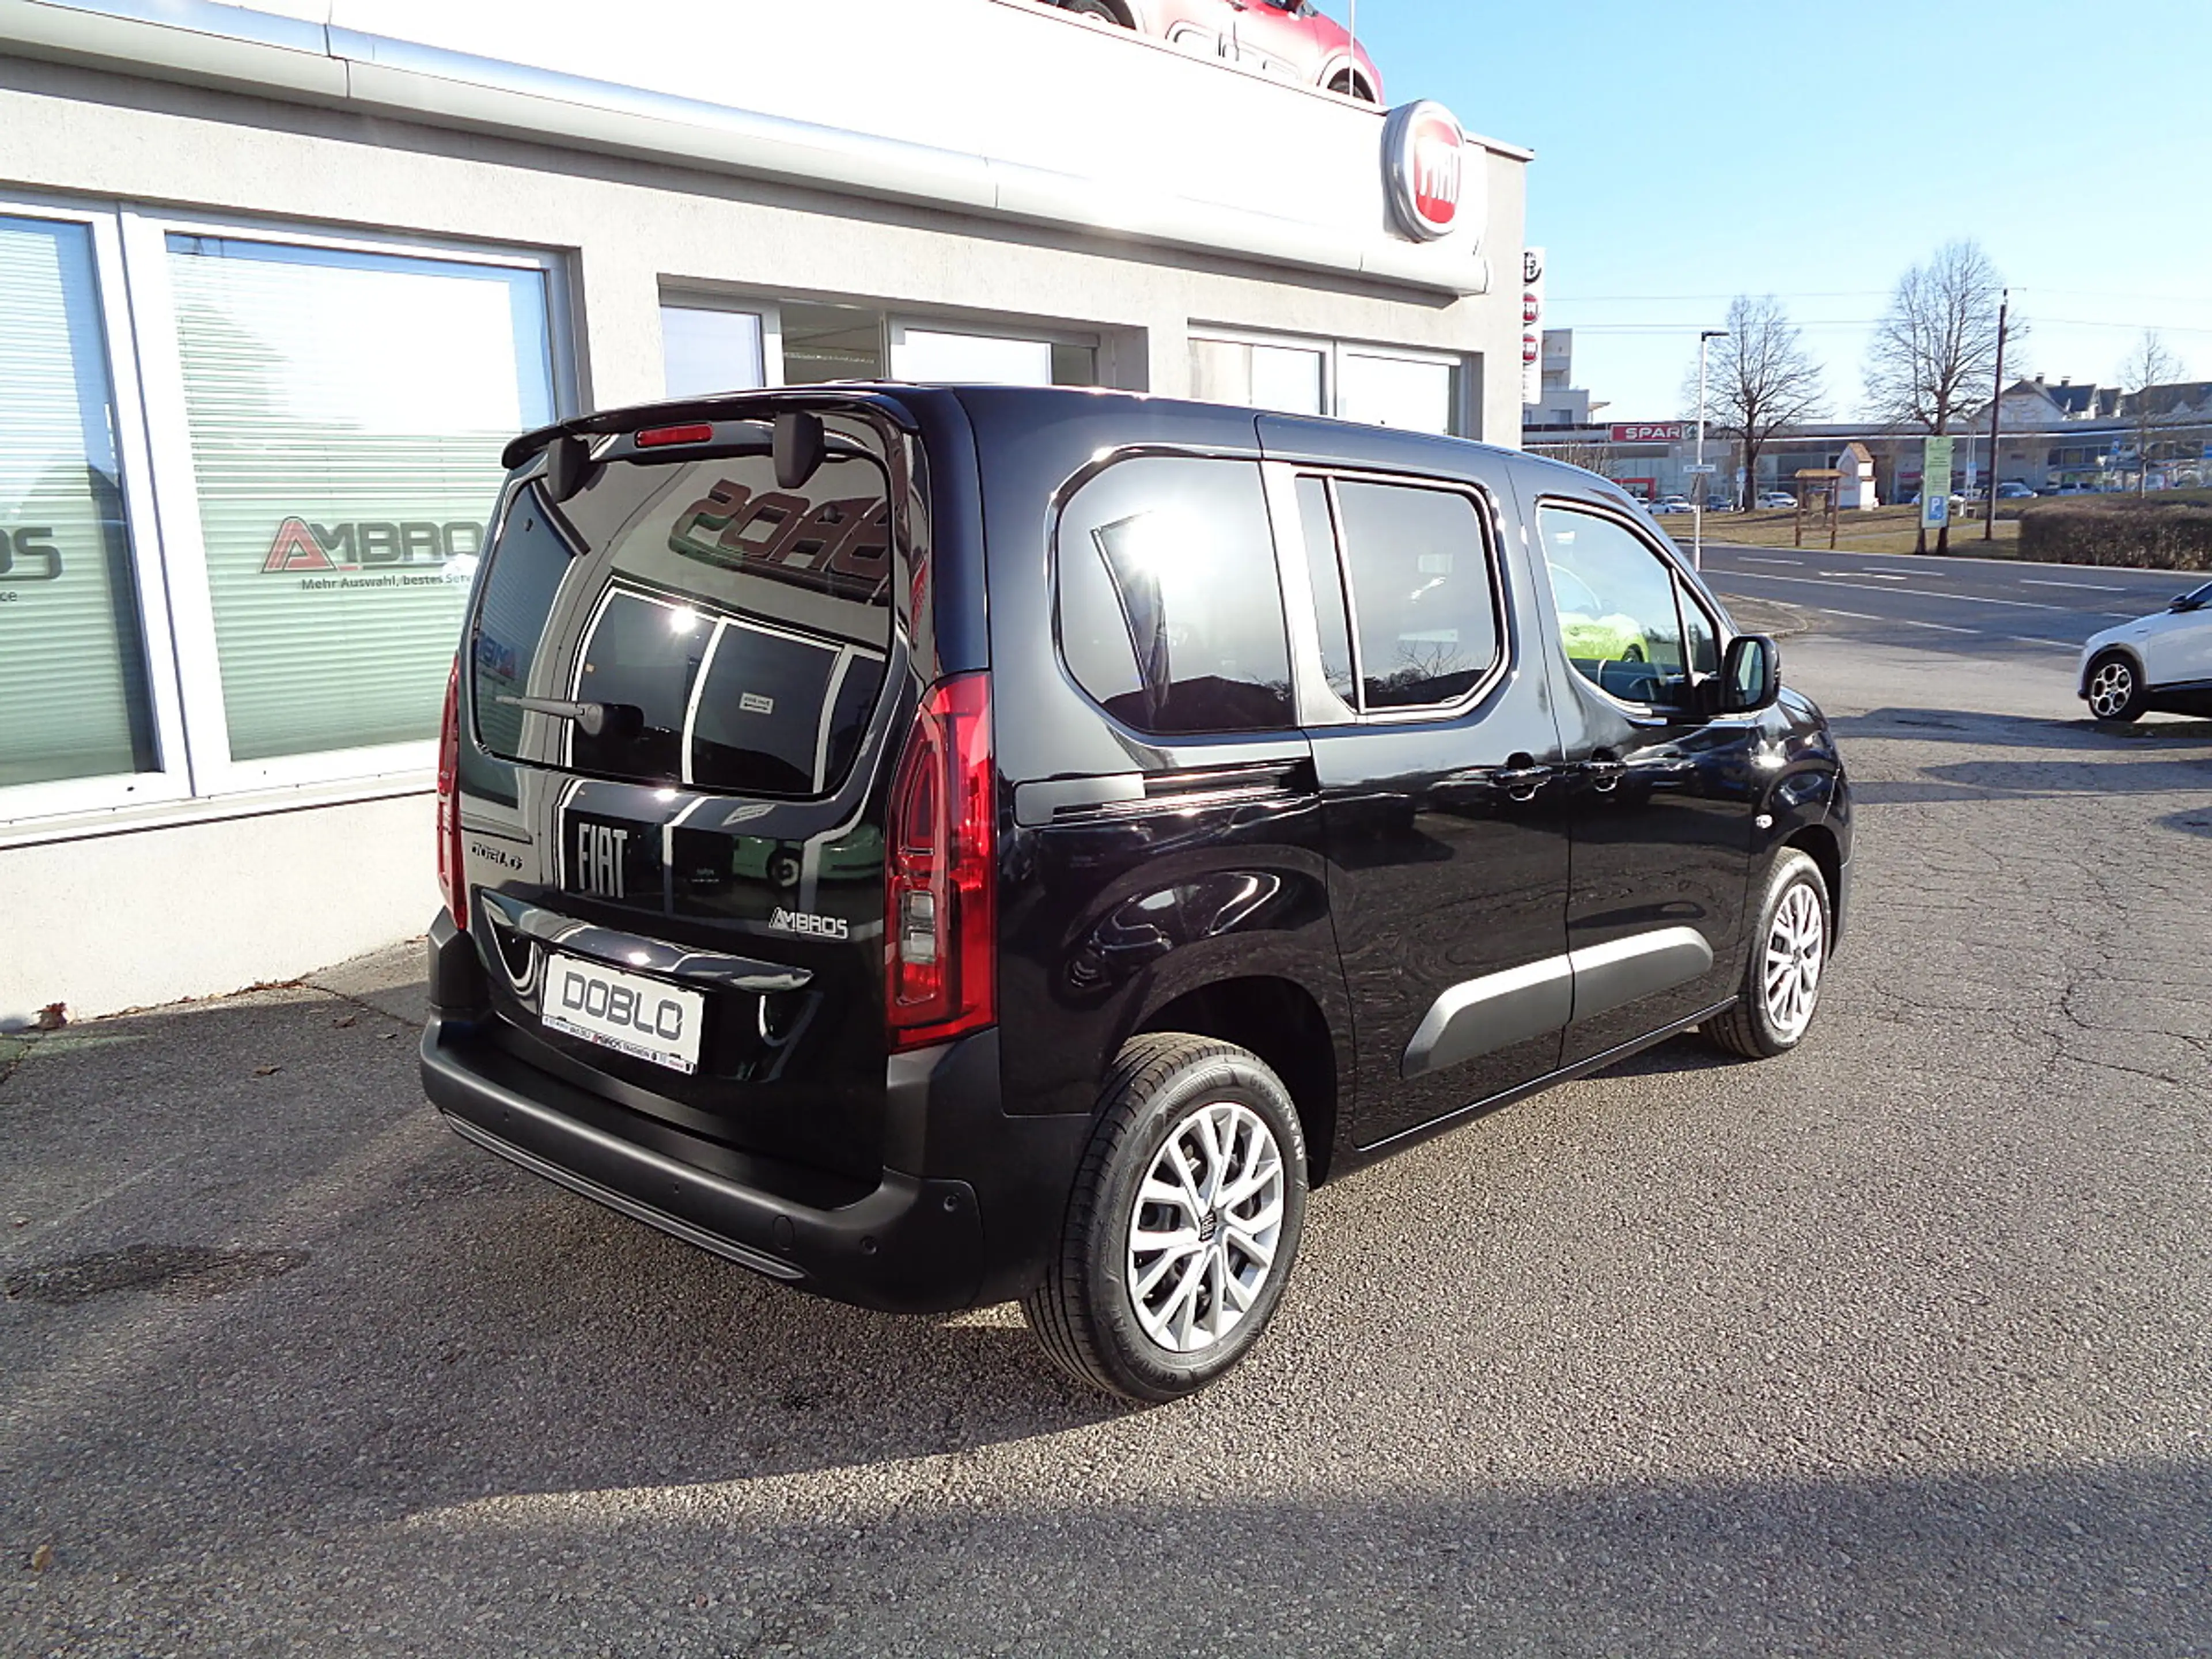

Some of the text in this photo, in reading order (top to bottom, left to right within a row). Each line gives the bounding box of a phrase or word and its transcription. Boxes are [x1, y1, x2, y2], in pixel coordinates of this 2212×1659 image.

[1625, 427, 1680, 440] SPAR
[302, 578, 337, 590] Mehr
[340, 575, 399, 588] Auswahl,
[403, 575, 443, 585] bestes
[578, 823, 628, 898] FIAT
[768, 907, 848, 939] AMBROS
[562, 971, 683, 1040] DOBLO
